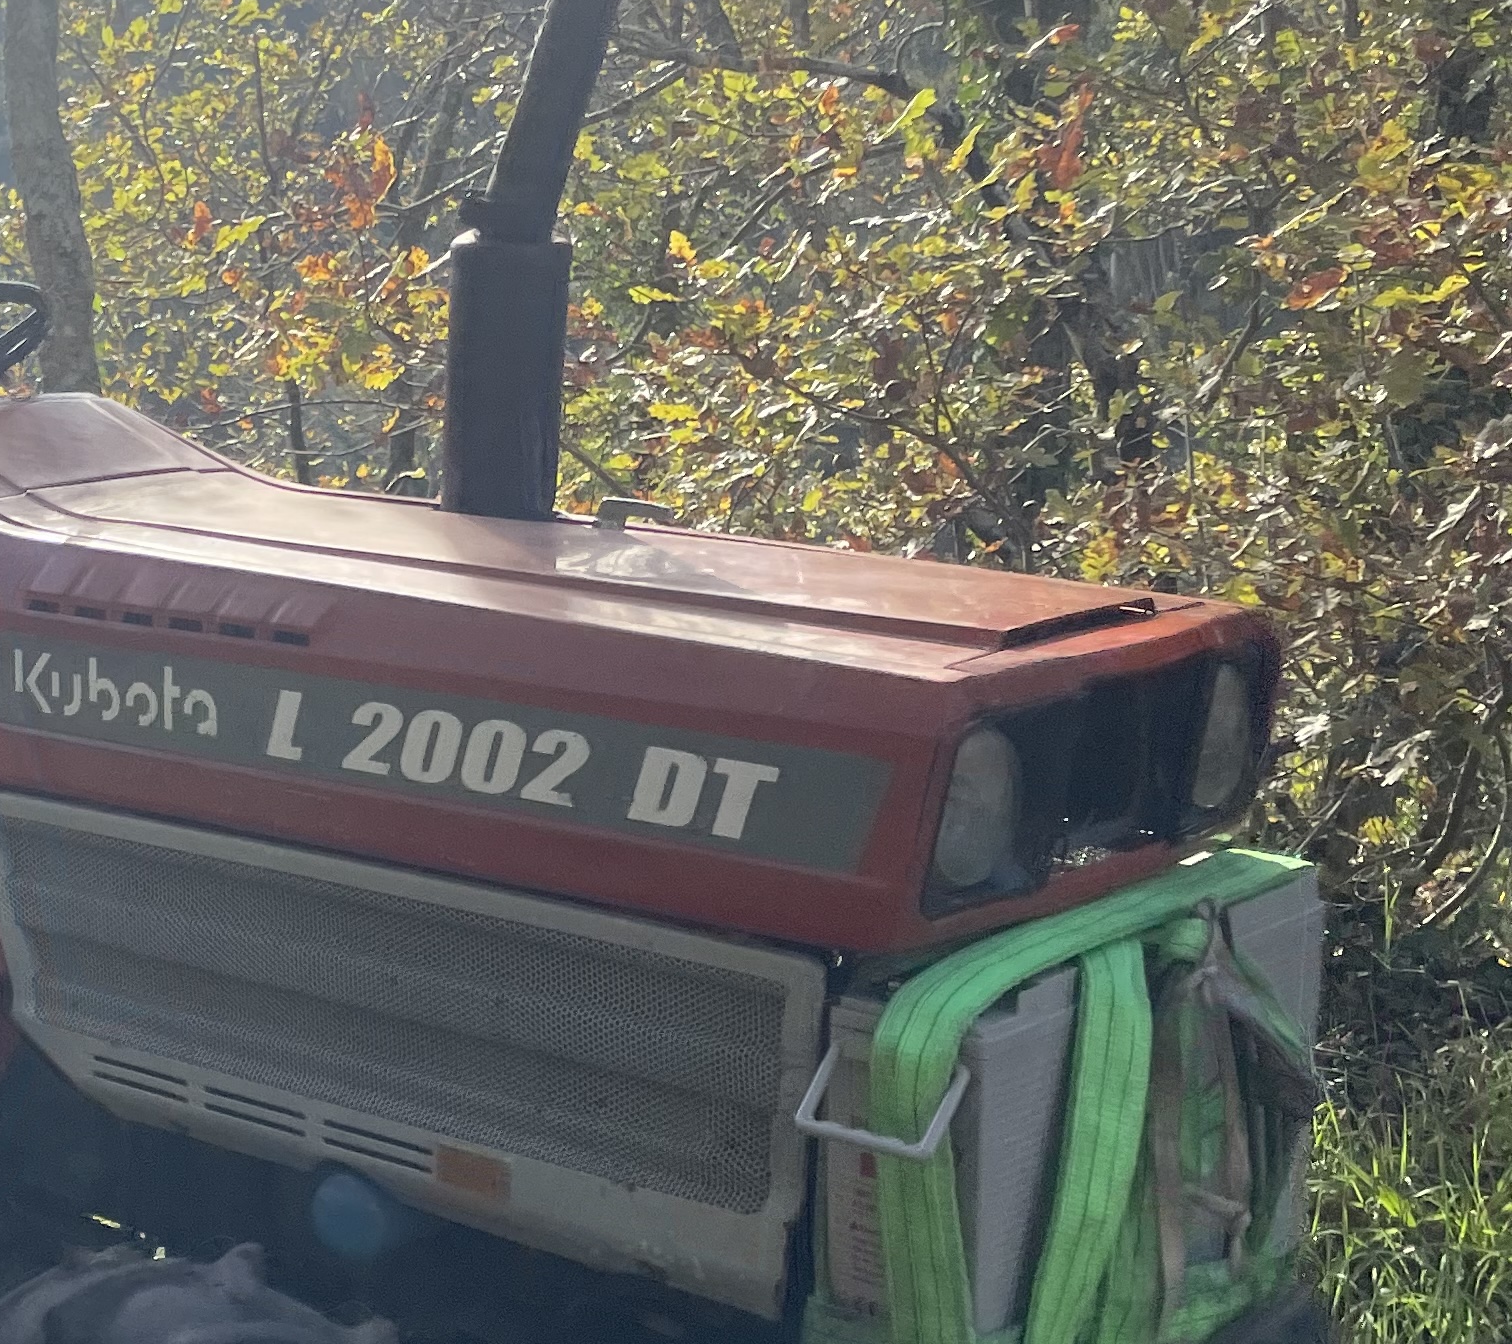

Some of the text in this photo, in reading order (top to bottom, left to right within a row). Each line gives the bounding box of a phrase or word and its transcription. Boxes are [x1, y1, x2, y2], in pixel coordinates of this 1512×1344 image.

[13, 648, 780, 840] Kubota L 2002 DT
